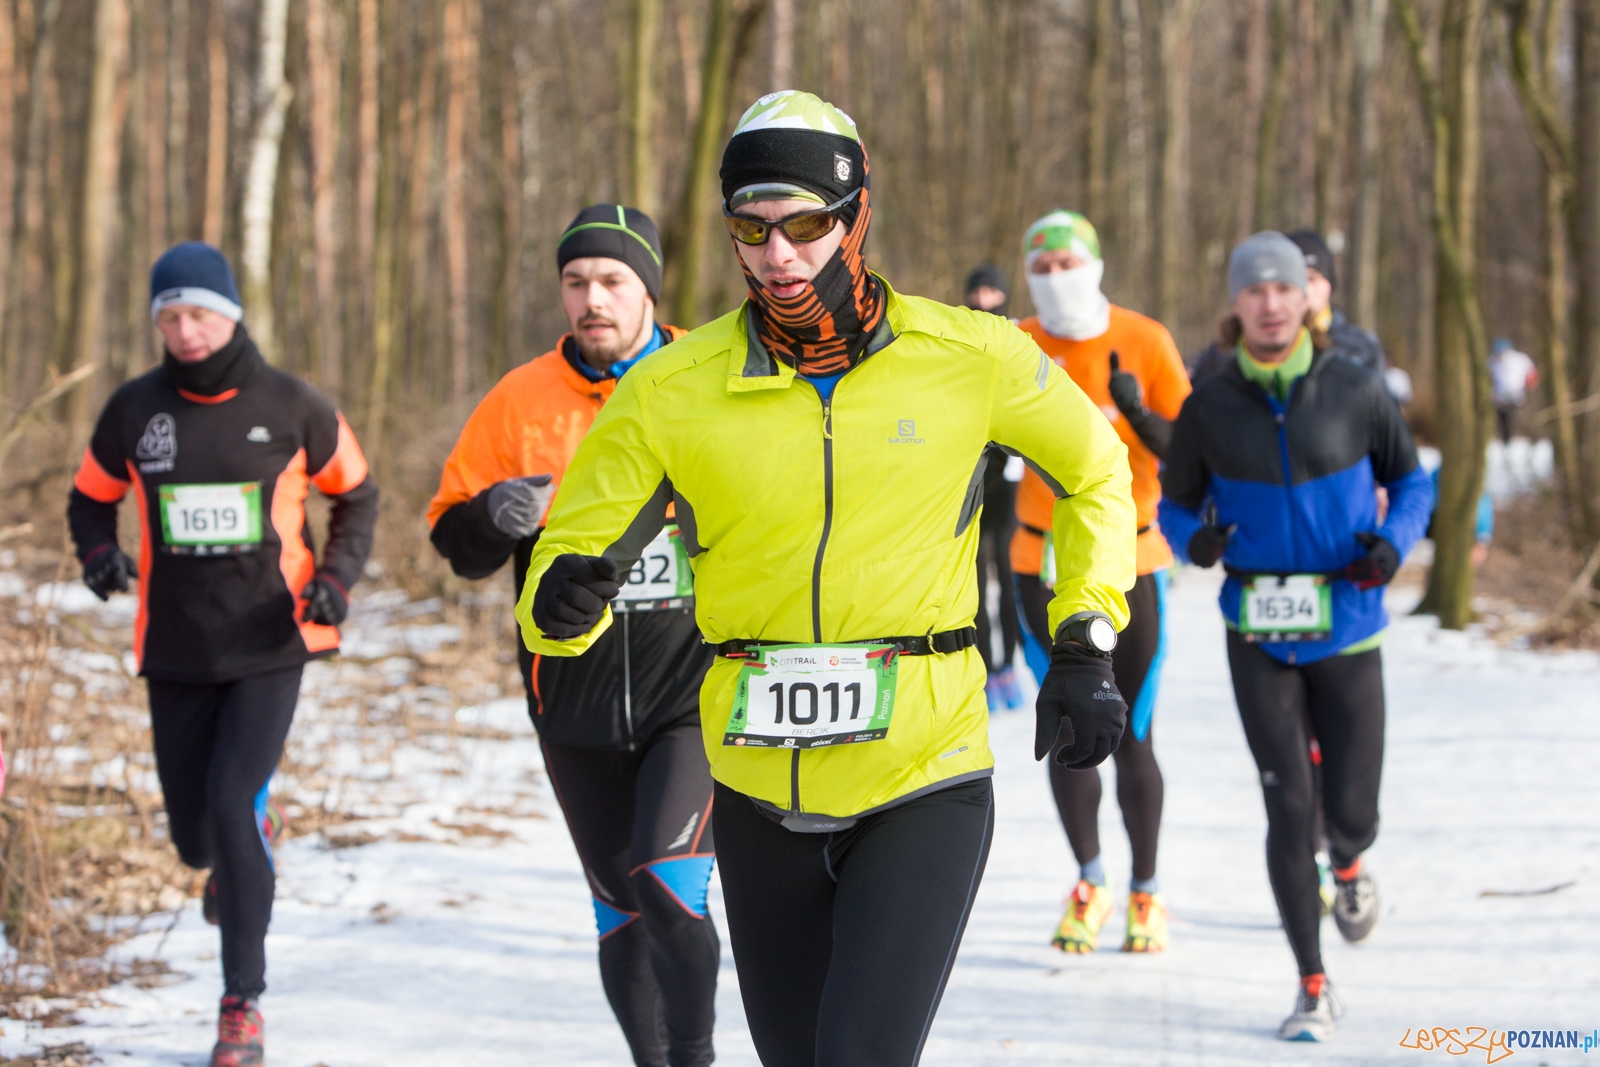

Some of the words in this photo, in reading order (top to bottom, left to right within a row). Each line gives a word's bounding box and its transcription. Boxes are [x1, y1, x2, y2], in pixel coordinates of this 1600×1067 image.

[180, 507, 238, 531] 1619
[1256, 596, 1313, 619] 1634
[769, 682, 861, 726] 1011
[878, 689, 891, 720] Poznań
[792, 727, 830, 736] BERCIK
